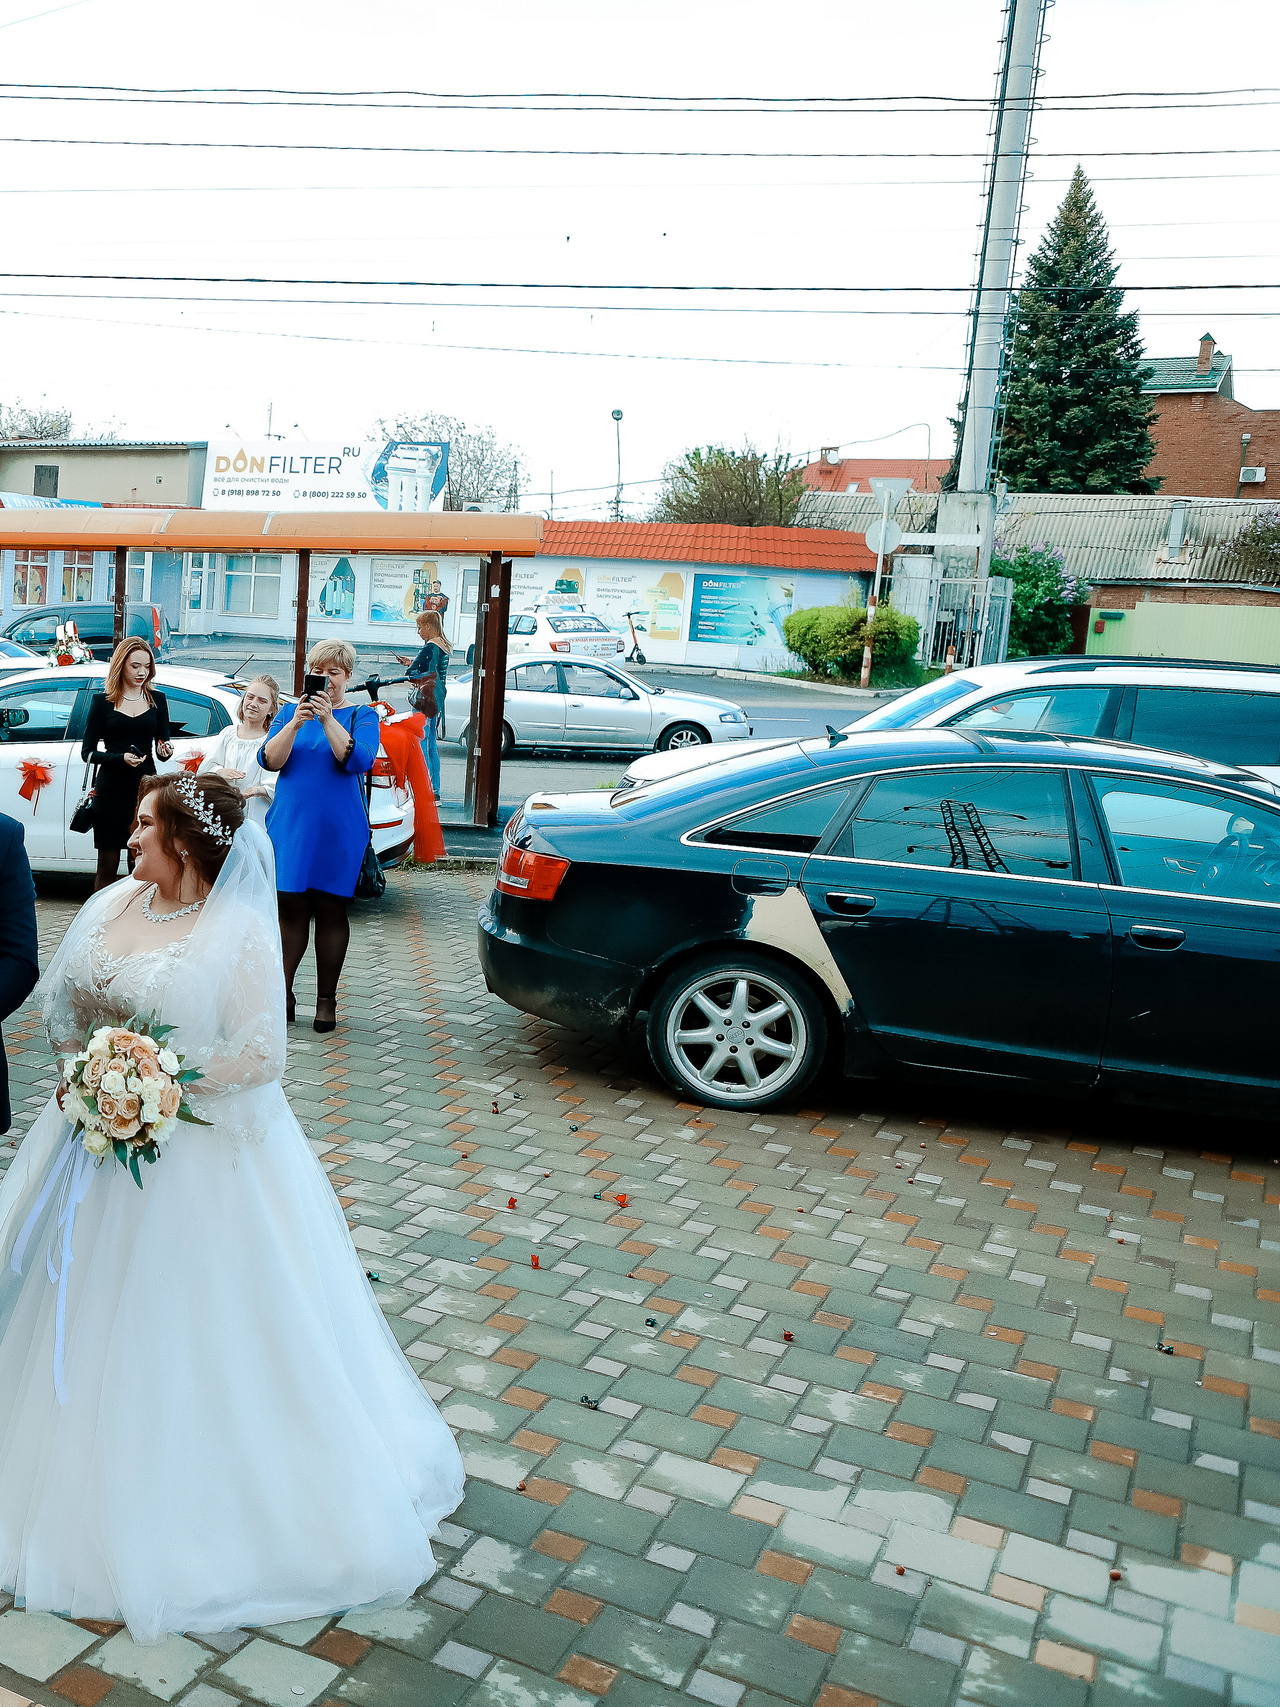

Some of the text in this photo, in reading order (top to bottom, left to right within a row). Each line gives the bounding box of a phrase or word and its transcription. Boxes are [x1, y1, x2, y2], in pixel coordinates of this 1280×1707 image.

[342, 447, 361, 457] RU
[227, 489, 244, 497] (918)
[309, 490, 329, 499] (800)
[357, 491, 367, 499] 50
